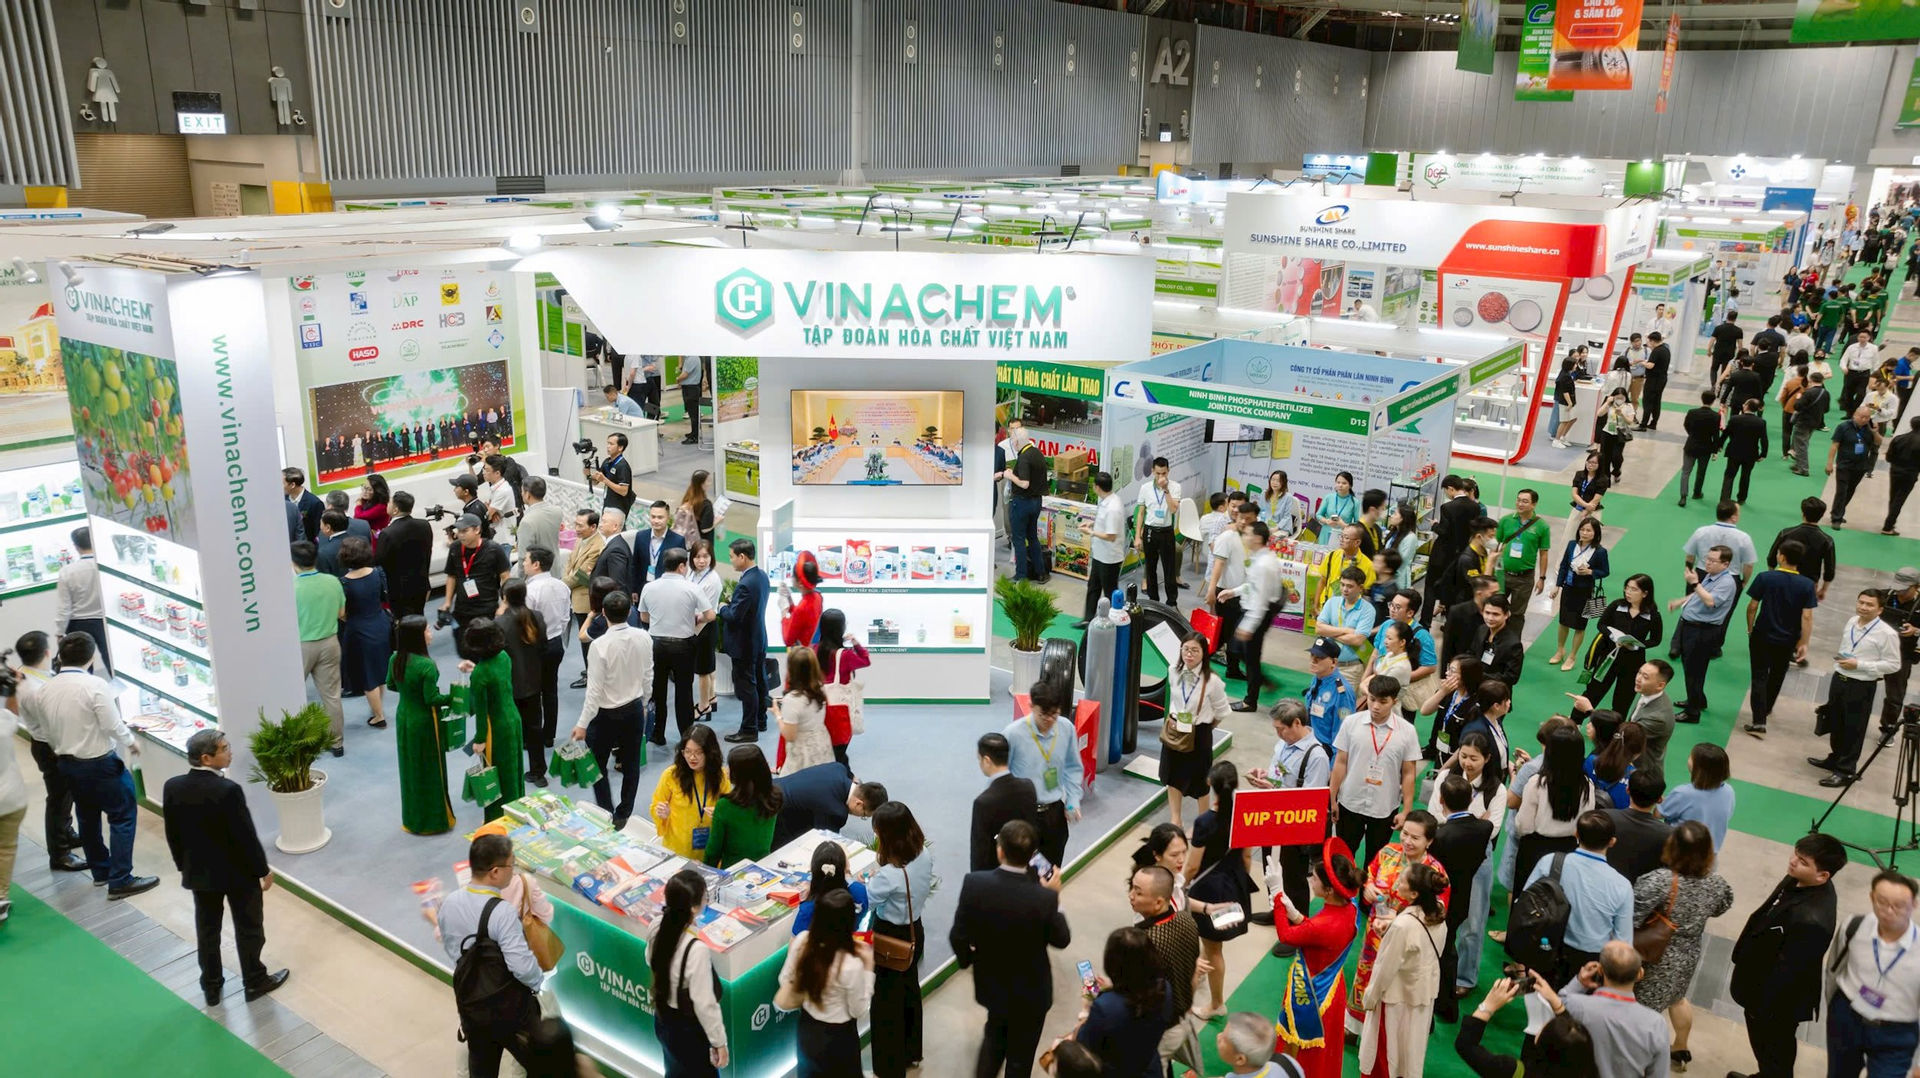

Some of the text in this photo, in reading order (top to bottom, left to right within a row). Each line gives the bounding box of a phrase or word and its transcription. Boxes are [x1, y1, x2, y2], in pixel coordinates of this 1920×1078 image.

[1150, 37, 1191, 86] A2
[183, 116, 221, 128] EXIT
[1250, 233, 1407, 253] SUNSHINE SHARE CO.,LIMITED
[1300, 225, 1356, 236] SUNSHINE SHARE
[1465, 241, 1560, 256] www.sunshineshare.cn
[80, 291, 153, 322] VINACHEM
[783, 279, 1063, 321] VINACHEM
[402, 319, 425, 330] DRC
[803, 324, 1068, 351] TẬP ĐOÀN HÓA CHẤT VIỆT NAM
[352, 347, 377, 359] HASO
[1013, 365, 1023, 386] VÀ
[1024, 367, 1039, 387] HÓA
[1041, 368, 1061, 391] CHẤT
[1061, 372, 1079, 394] LÂM
[1080, 377, 1100, 397] THAO
[1188, 390, 1314, 415] NINH BINH PHOSPHATEFERTILIZER
[1207, 402, 1367, 427] JOINTSTOCK COMPANY D15
[212, 334, 261, 633] www.vinachem.com.vn
[1243, 808, 1318, 827] VIP TOUR
